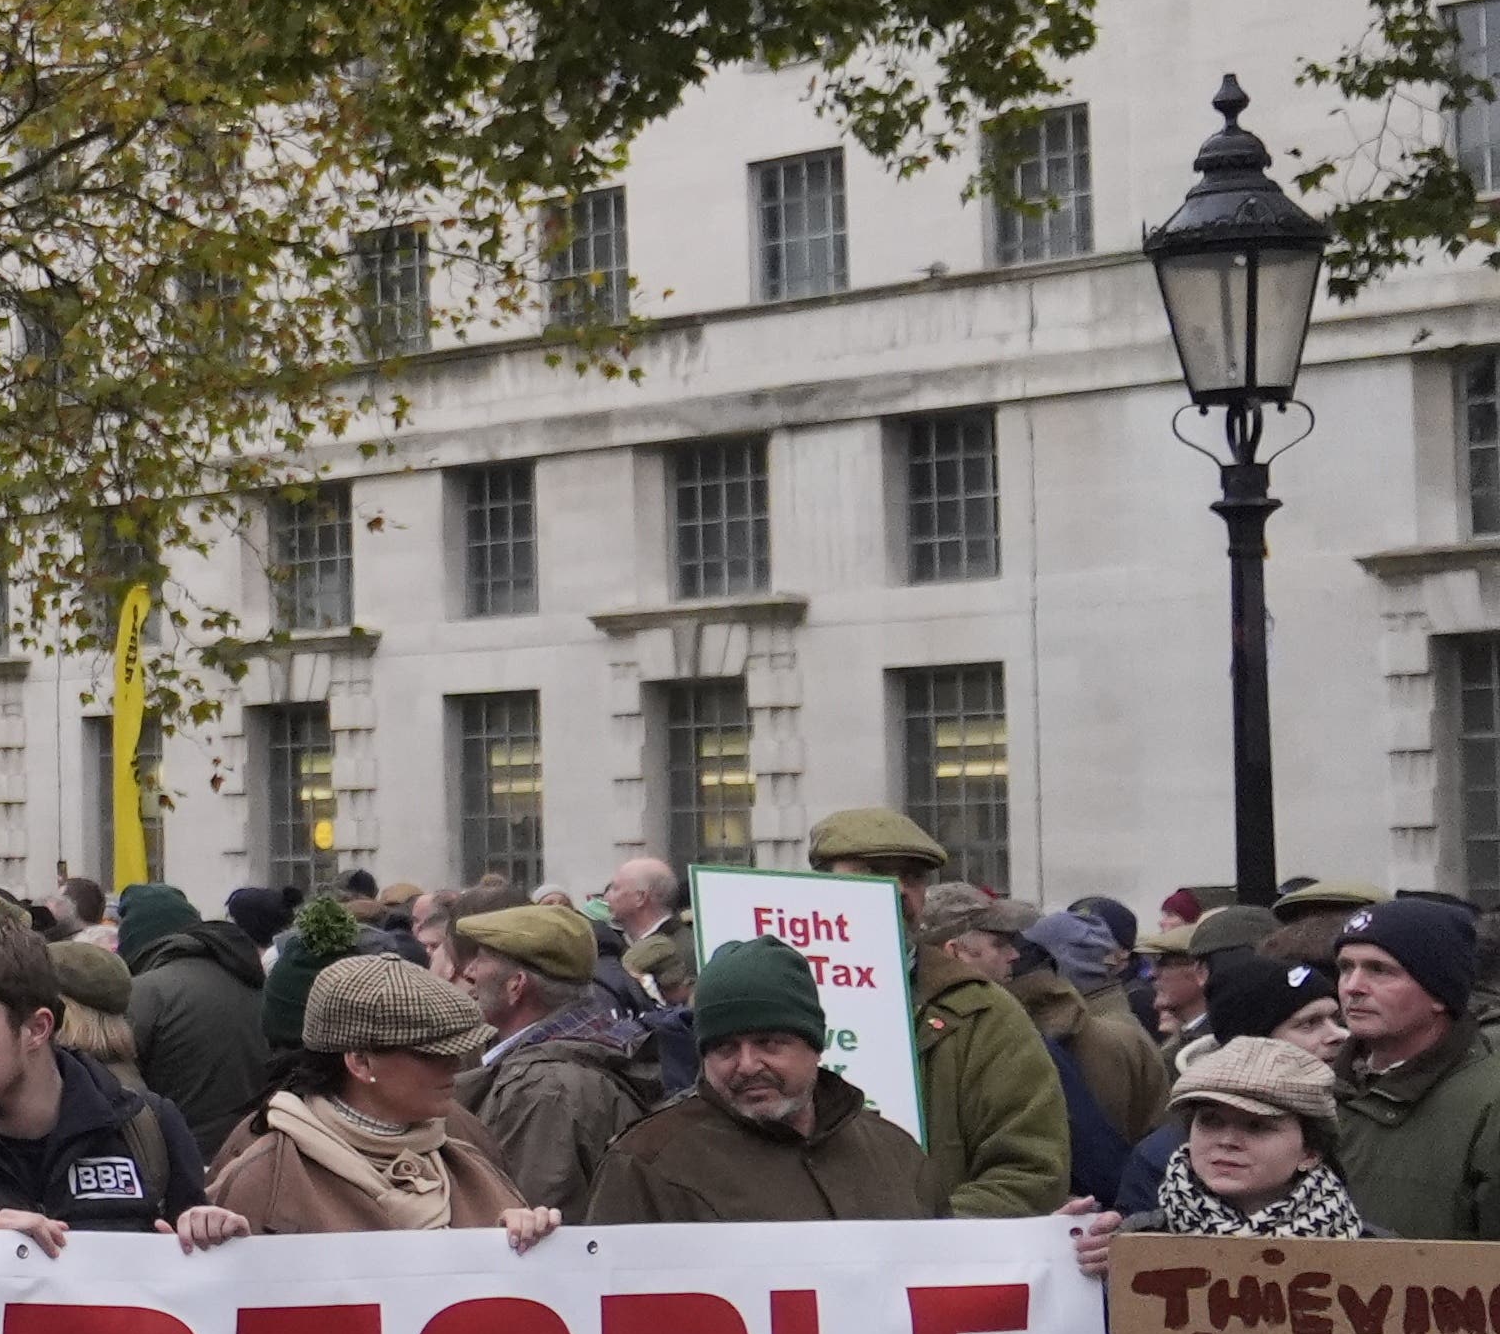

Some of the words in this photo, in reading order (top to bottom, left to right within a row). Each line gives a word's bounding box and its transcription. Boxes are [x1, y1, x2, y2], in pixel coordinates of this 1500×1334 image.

[752, 906, 850, 948] Fight
[806, 955, 877, 989] Tax
[77, 1165, 132, 1190] BBF
